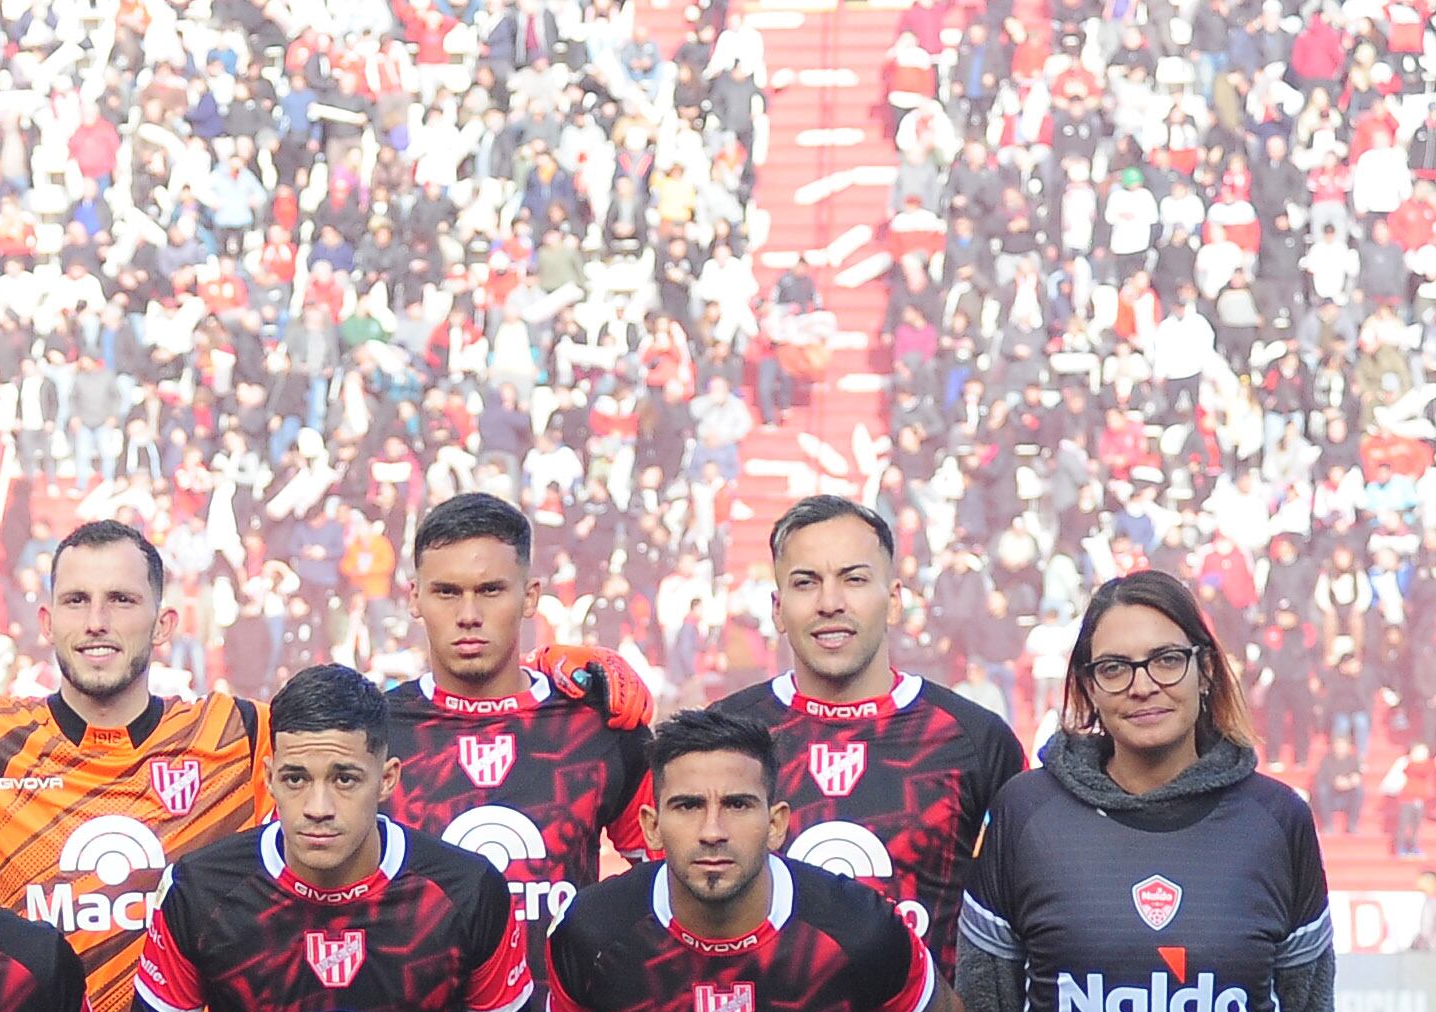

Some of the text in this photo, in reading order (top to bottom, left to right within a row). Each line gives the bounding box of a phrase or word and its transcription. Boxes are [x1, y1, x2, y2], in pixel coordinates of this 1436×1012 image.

[444, 695, 518, 714] GIVOVA
[806, 700, 878, 719] GIVOVA
[294, 881, 369, 903] GIVOVA
[681, 932, 759, 953] GIVOVA
